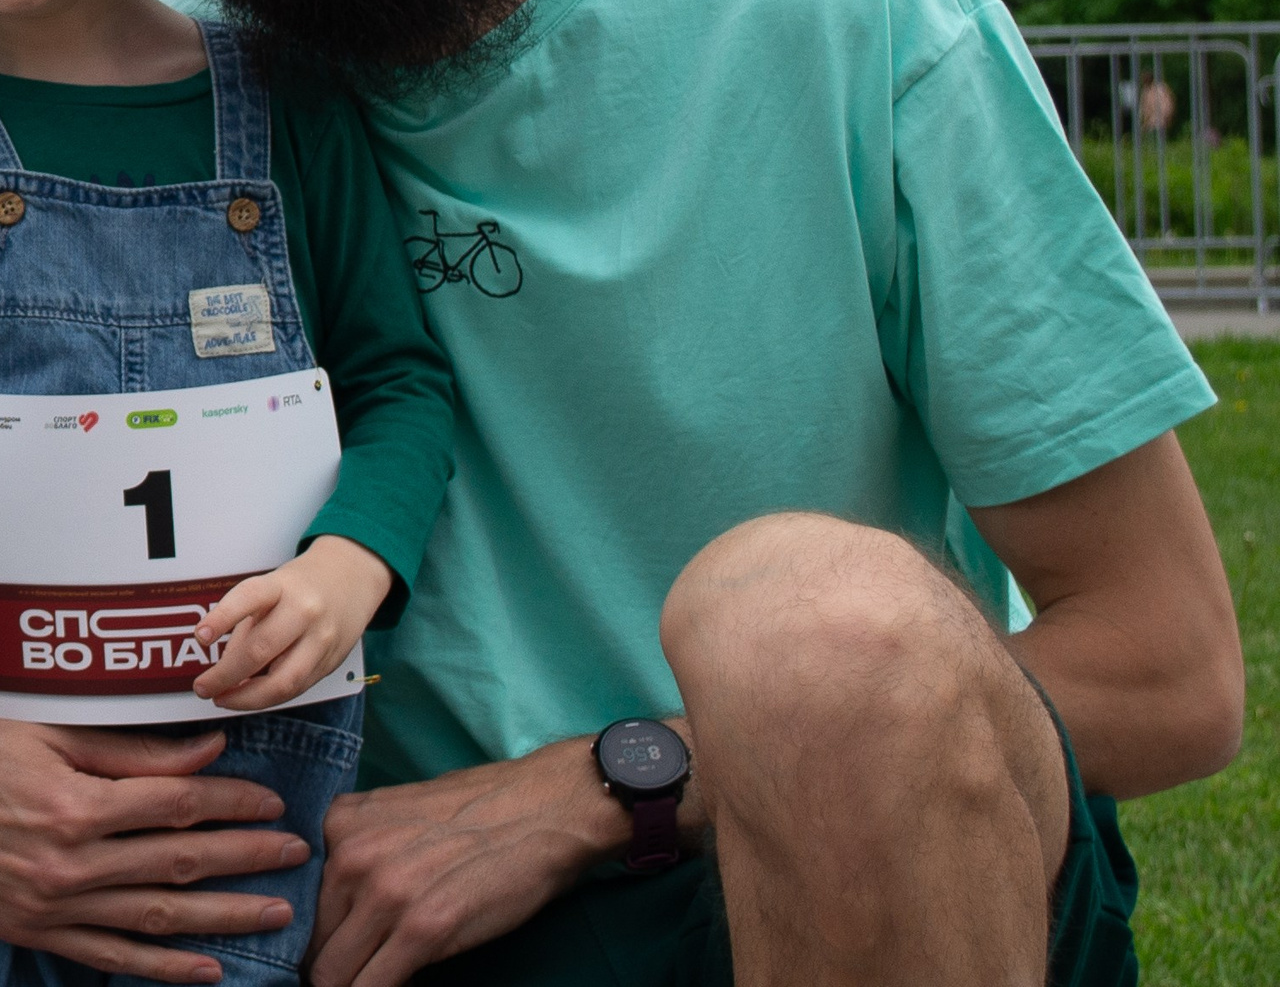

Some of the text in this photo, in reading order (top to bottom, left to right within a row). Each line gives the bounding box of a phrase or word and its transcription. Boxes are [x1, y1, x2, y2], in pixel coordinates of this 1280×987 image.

[202, 404, 249, 418] kaspersky
[283, 394, 302, 407] RTA
[53, 415, 77, 423] СПОРТ
[123, 469, 176, 560] 1
[19, 602, 220, 638] СПО
[22, 633, 232, 671] ВО БЛАГ
